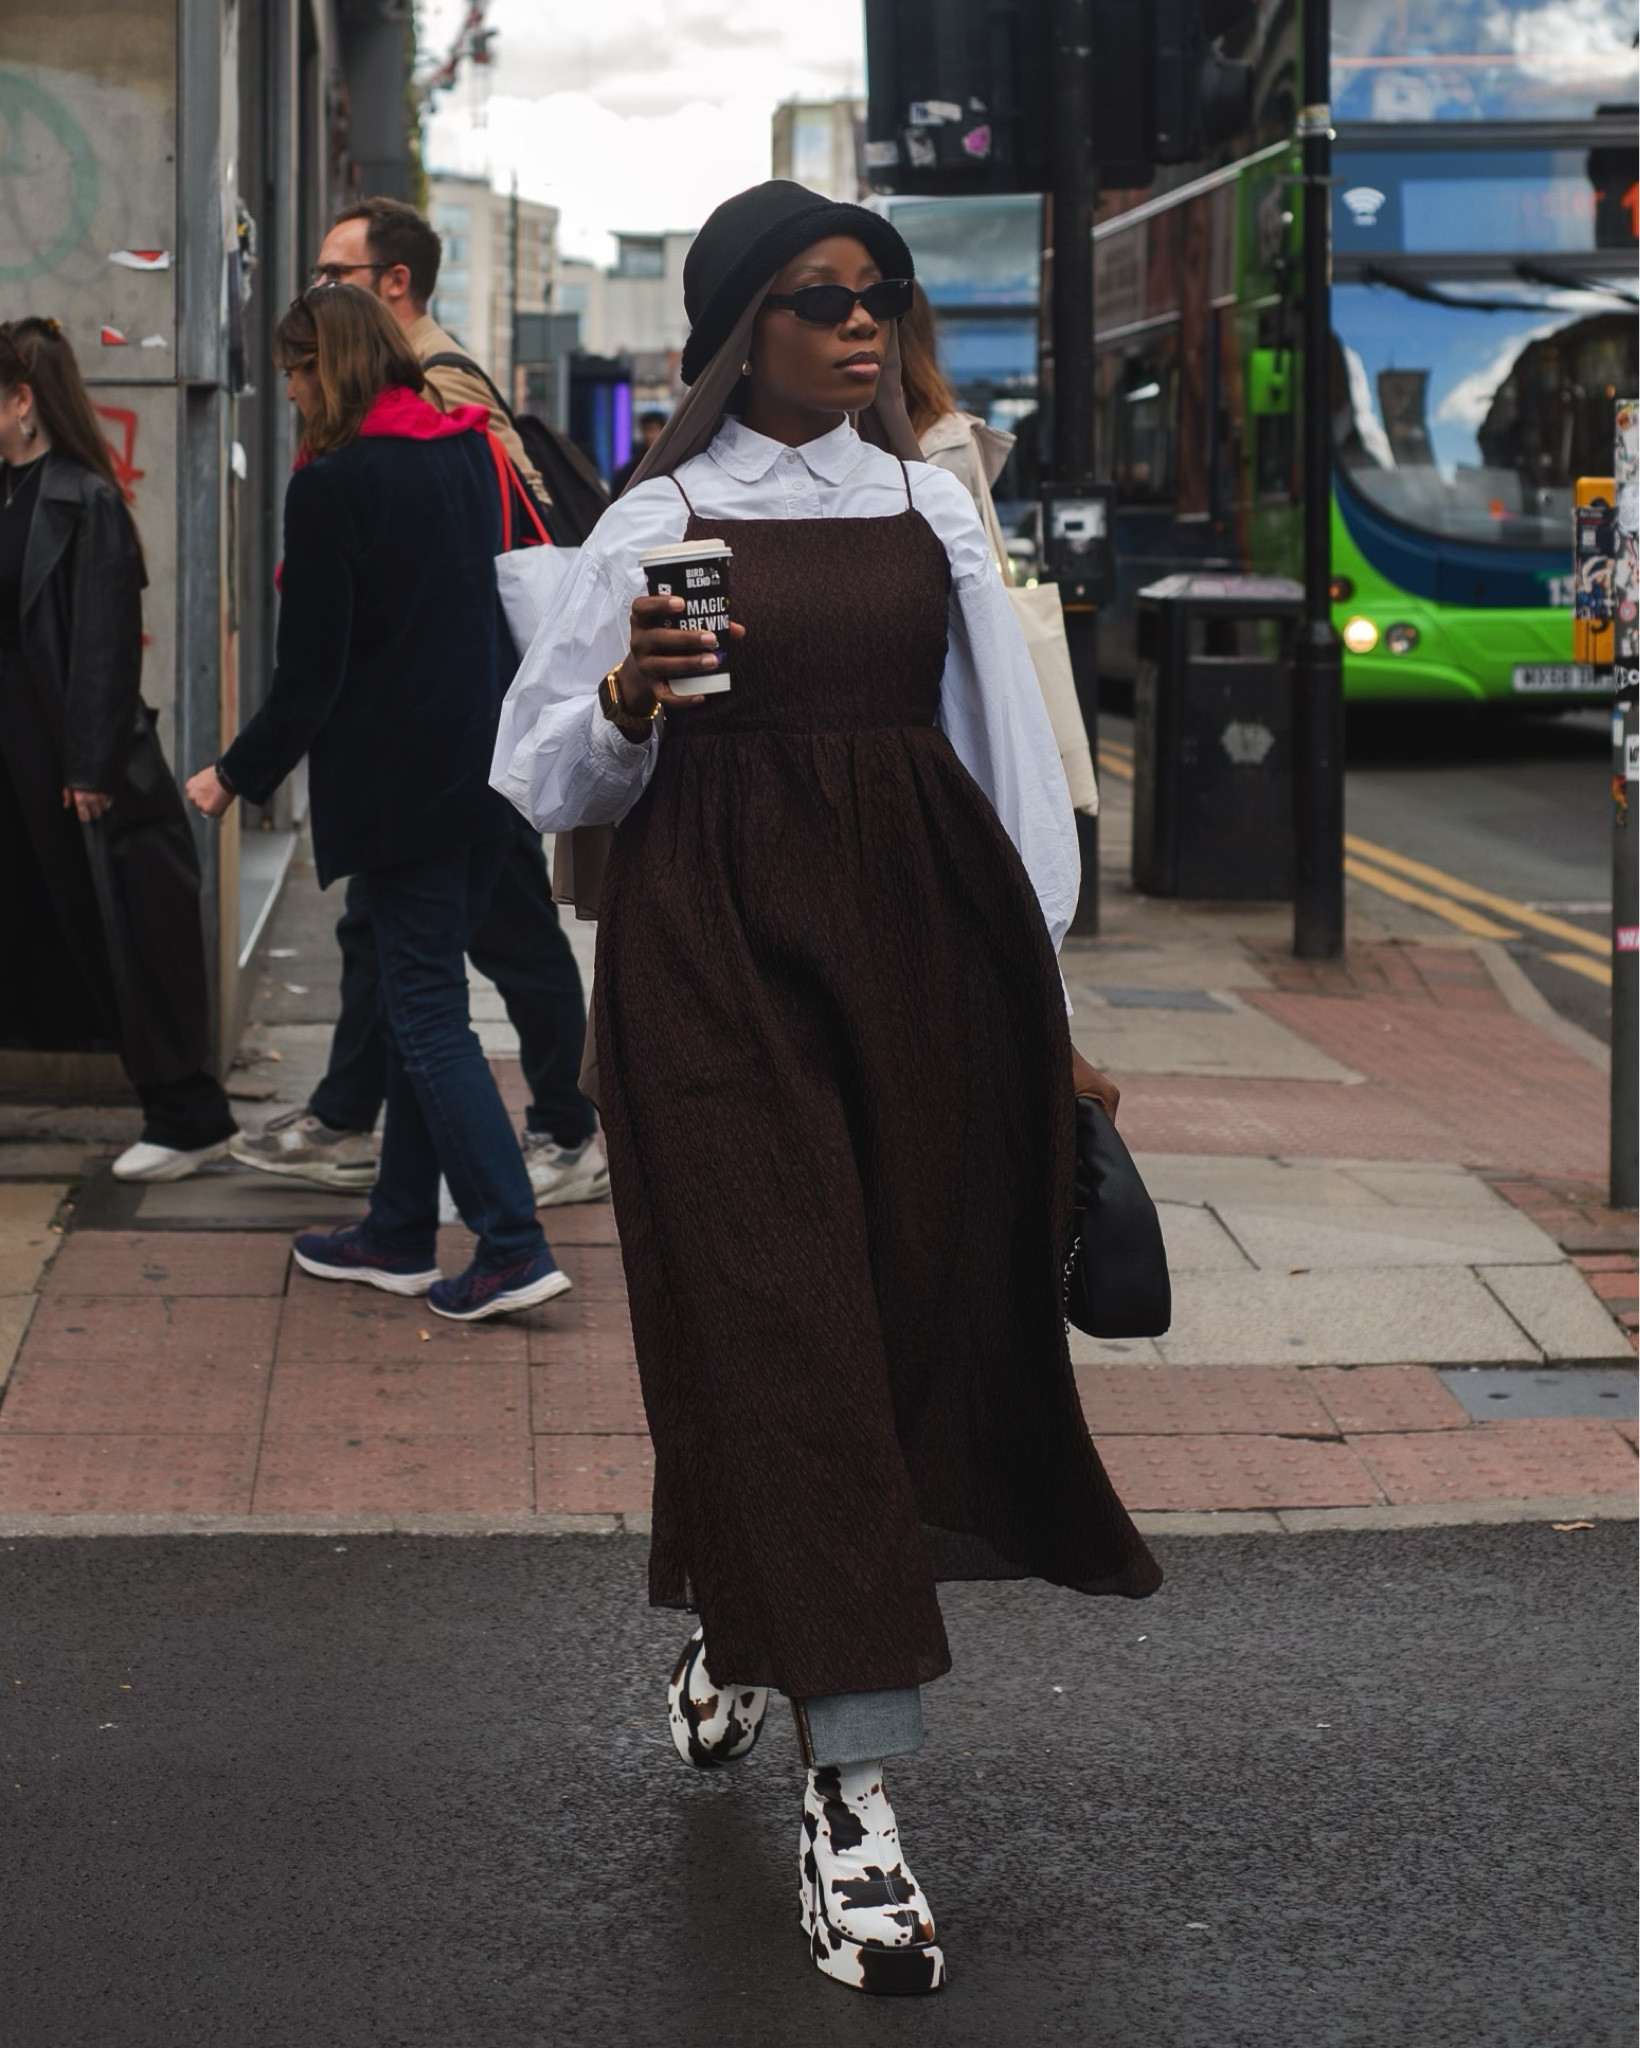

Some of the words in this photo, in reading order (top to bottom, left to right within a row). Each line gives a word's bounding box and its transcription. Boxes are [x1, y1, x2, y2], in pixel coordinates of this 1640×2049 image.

[686, 568, 704, 578] BIRD
[687, 577, 711, 588] BLEND
[687, 597, 726, 616] MAGIC
